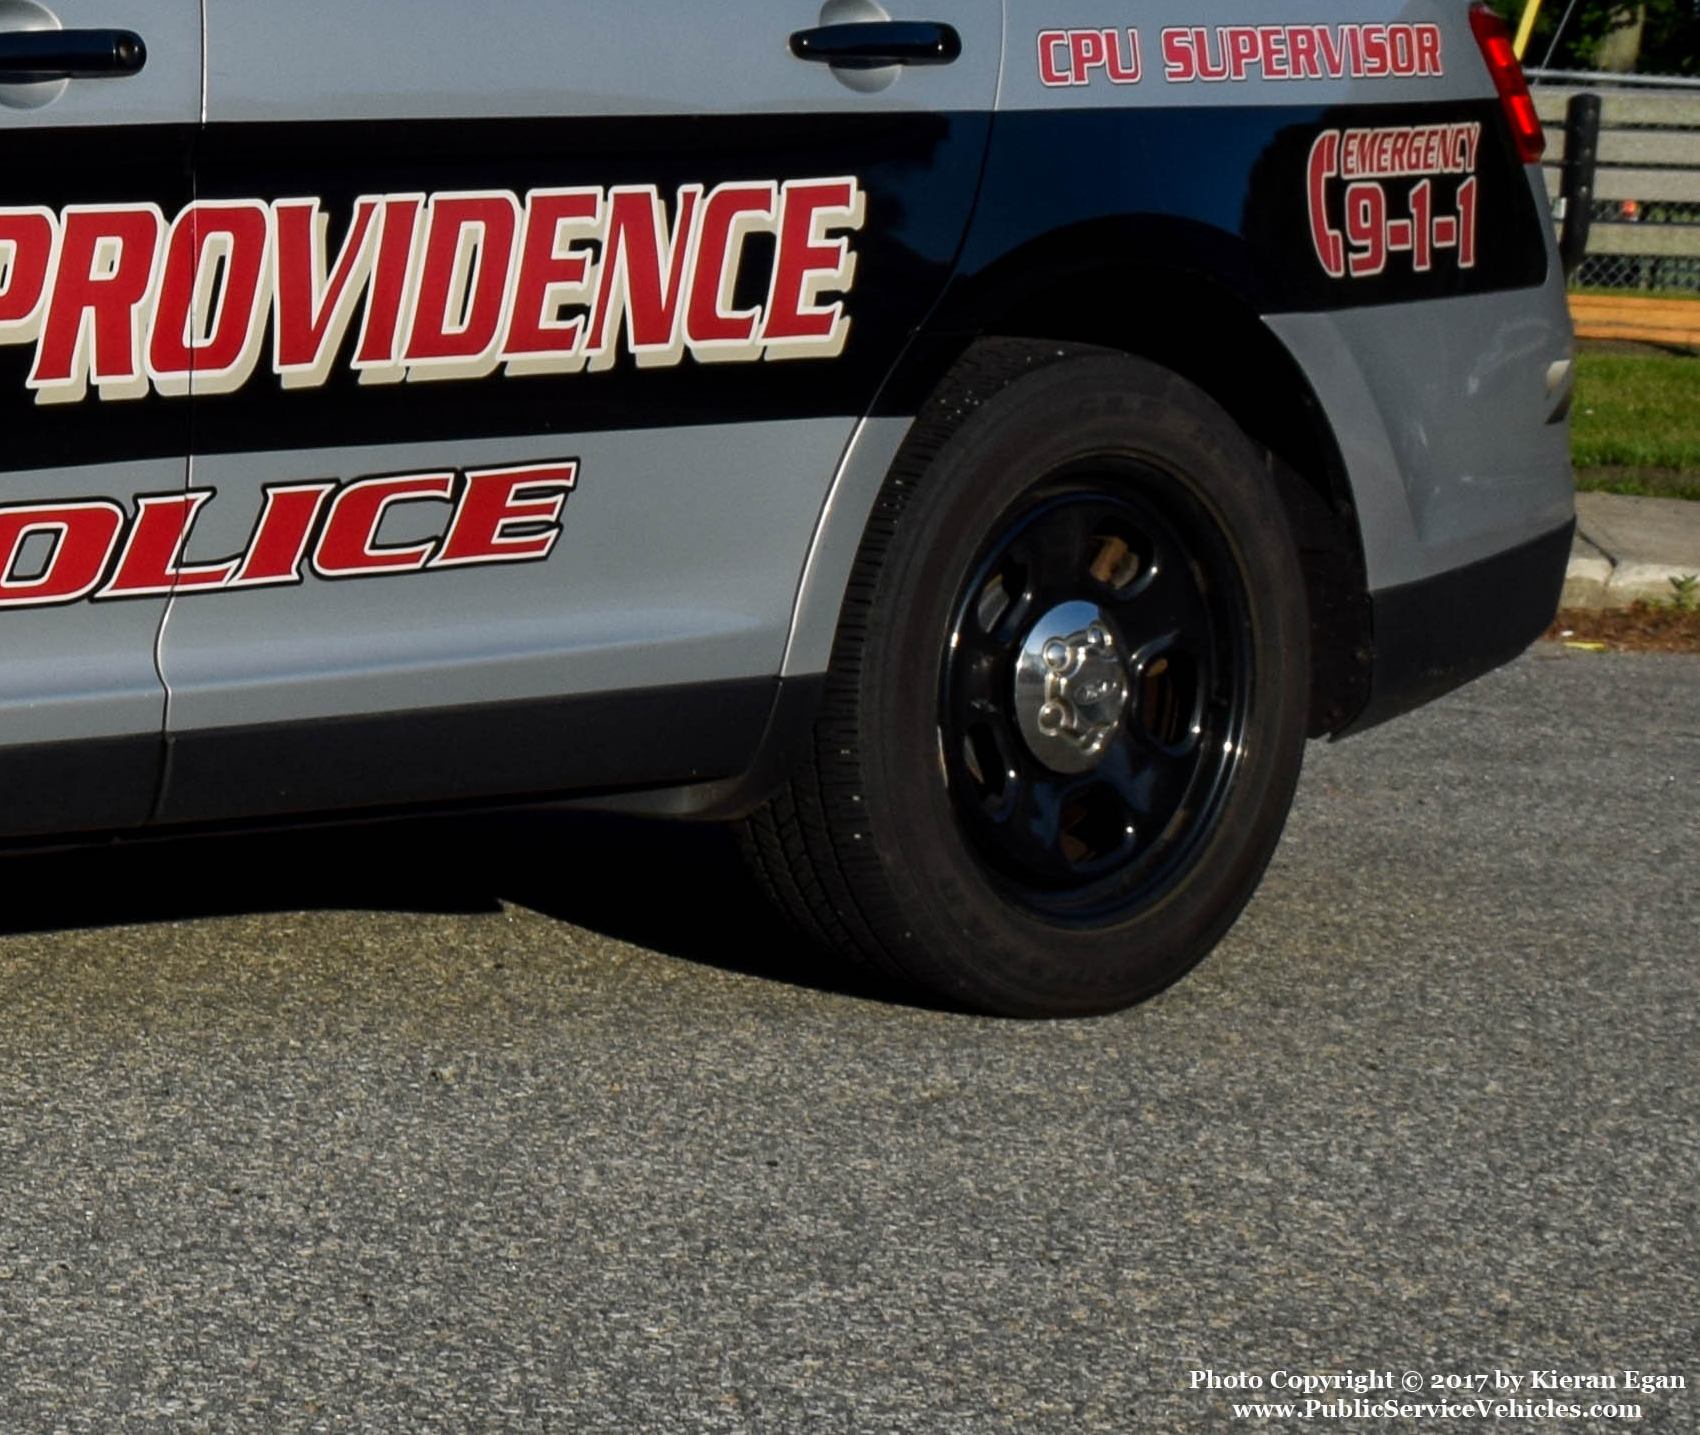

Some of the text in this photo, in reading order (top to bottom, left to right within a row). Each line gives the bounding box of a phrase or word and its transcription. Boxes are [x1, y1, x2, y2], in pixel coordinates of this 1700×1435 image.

[1037, 23, 1444, 86] CPU SUPERVISOR
[1340, 122, 1481, 179] EMERGENCY
[1345, 178, 1477, 277] 9-1-1
